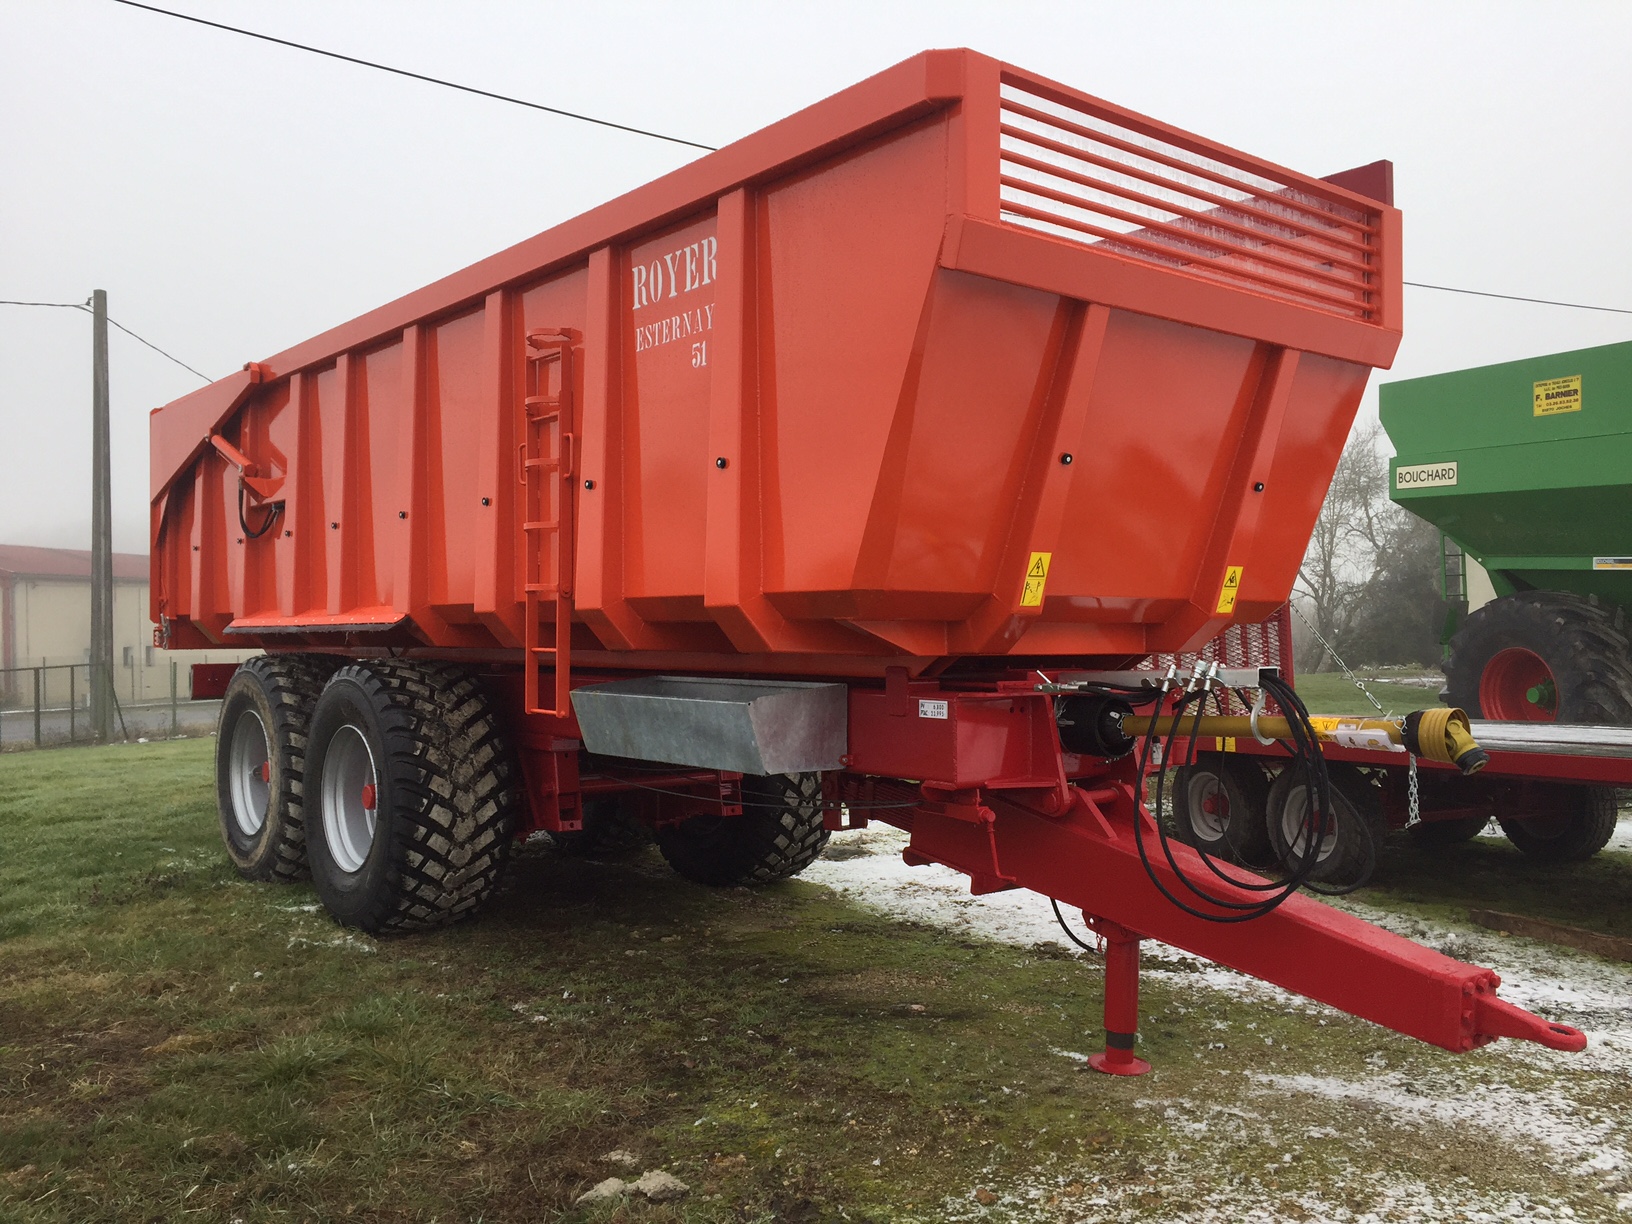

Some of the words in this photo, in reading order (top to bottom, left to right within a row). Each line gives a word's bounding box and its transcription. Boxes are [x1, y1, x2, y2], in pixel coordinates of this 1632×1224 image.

[631, 236, 718, 310] ROYER
[635, 303, 715, 352] ESTERNAY
[691, 340, 707, 368] 51
[1535, 394, 1543, 402] F.
[1545, 389, 1579, 401] BARNIER
[1398, 468, 1455, 483] BOUCHARD
